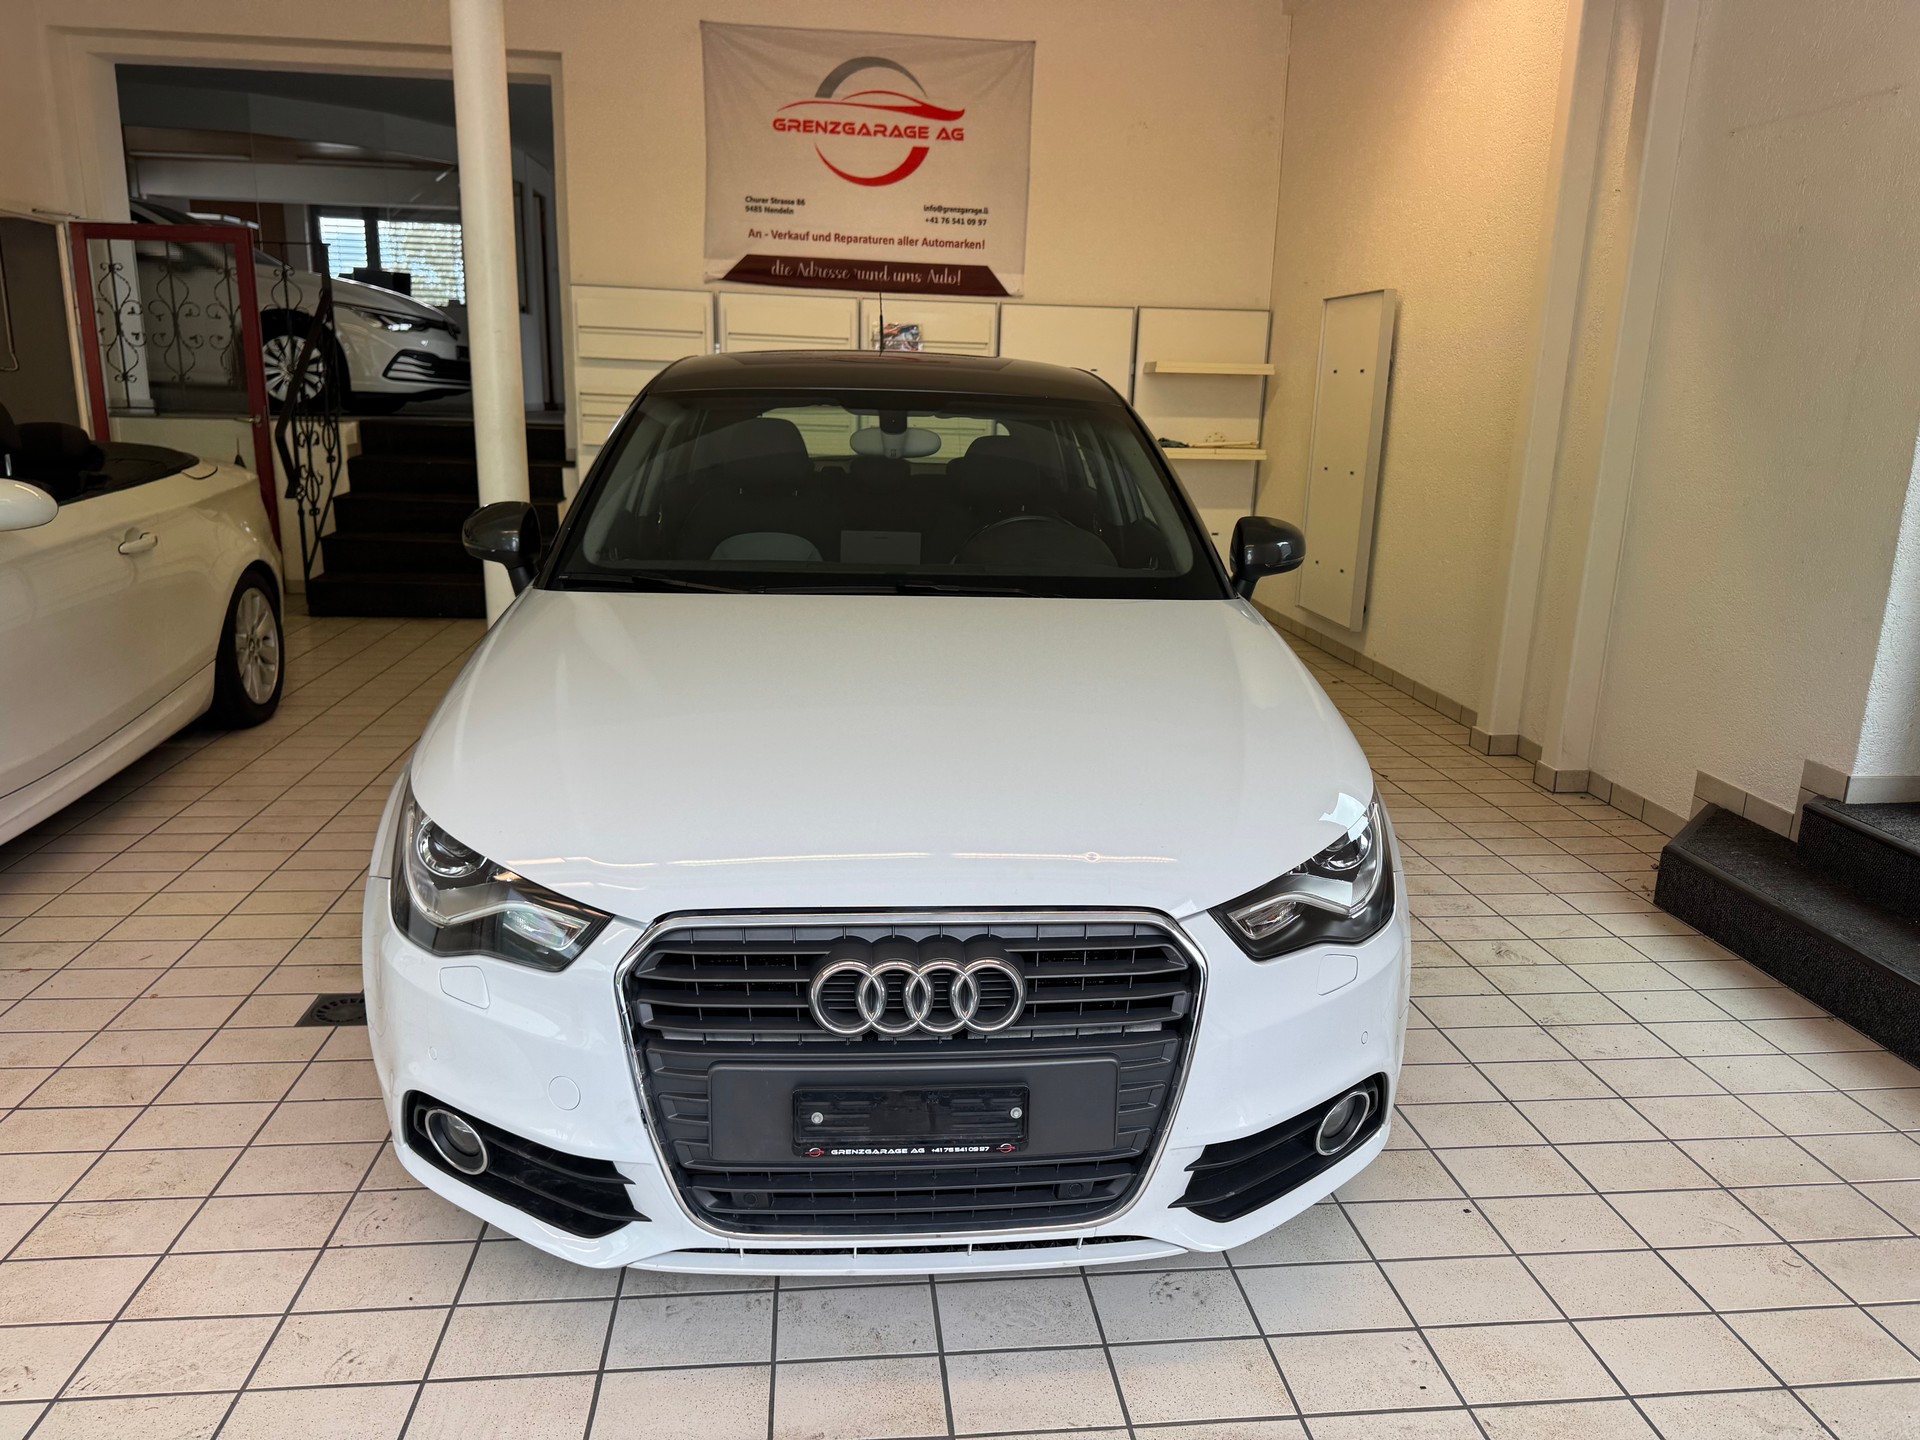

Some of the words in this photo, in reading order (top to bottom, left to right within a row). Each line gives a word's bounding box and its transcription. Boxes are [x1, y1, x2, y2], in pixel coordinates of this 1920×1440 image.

[773, 118, 930, 139] GRENZGARAGE
[936, 127, 965, 141] AG
[744, 195, 769, 204] Churer
[770, 197, 795, 206] Strasse
[764, 206, 795, 215] Nendeln
[941, 217, 951, 225] 76
[952, 217, 965, 225] 541
[966, 218, 976, 226] 09
[748, 228, 762, 239] An
[770, 229, 810, 241] Verkauf
[812, 232, 831, 243] und
[834, 232, 895, 246] Reparaturen
[897, 236, 920, 248] aller
[921, 237, 986, 250] Automarken!
[770, 260, 794, 277] die
[796, 260, 851, 280] Adresse
[853, 265, 891, 282] rund
[892, 271, 923, 284] ums
[926, 267, 962, 287] Auto!
